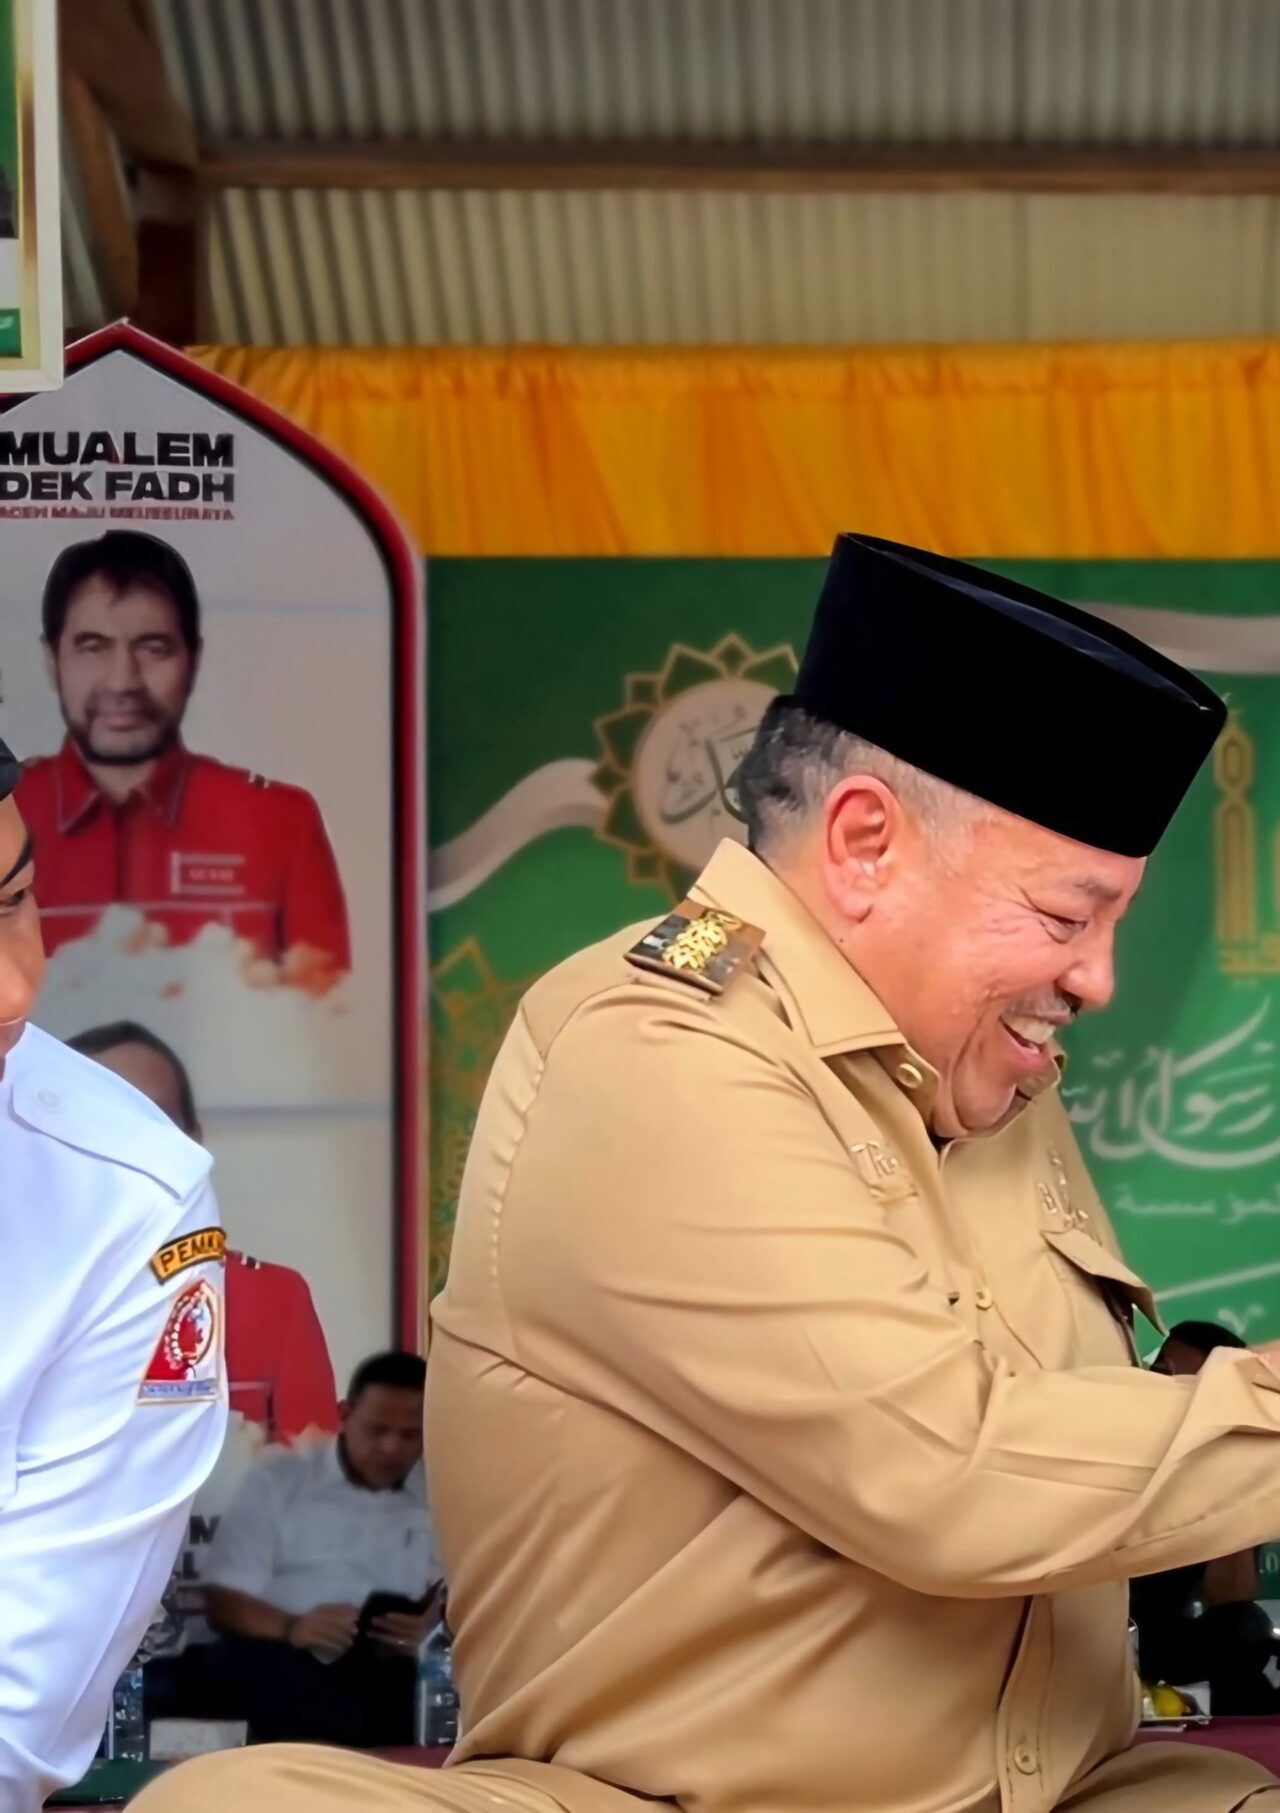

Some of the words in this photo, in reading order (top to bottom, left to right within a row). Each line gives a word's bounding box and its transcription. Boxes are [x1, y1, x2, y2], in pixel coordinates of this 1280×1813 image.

[0, 431, 234, 467] MUALEM
[0, 472, 93, 501] DEK
[105, 471, 234, 502] FADH
